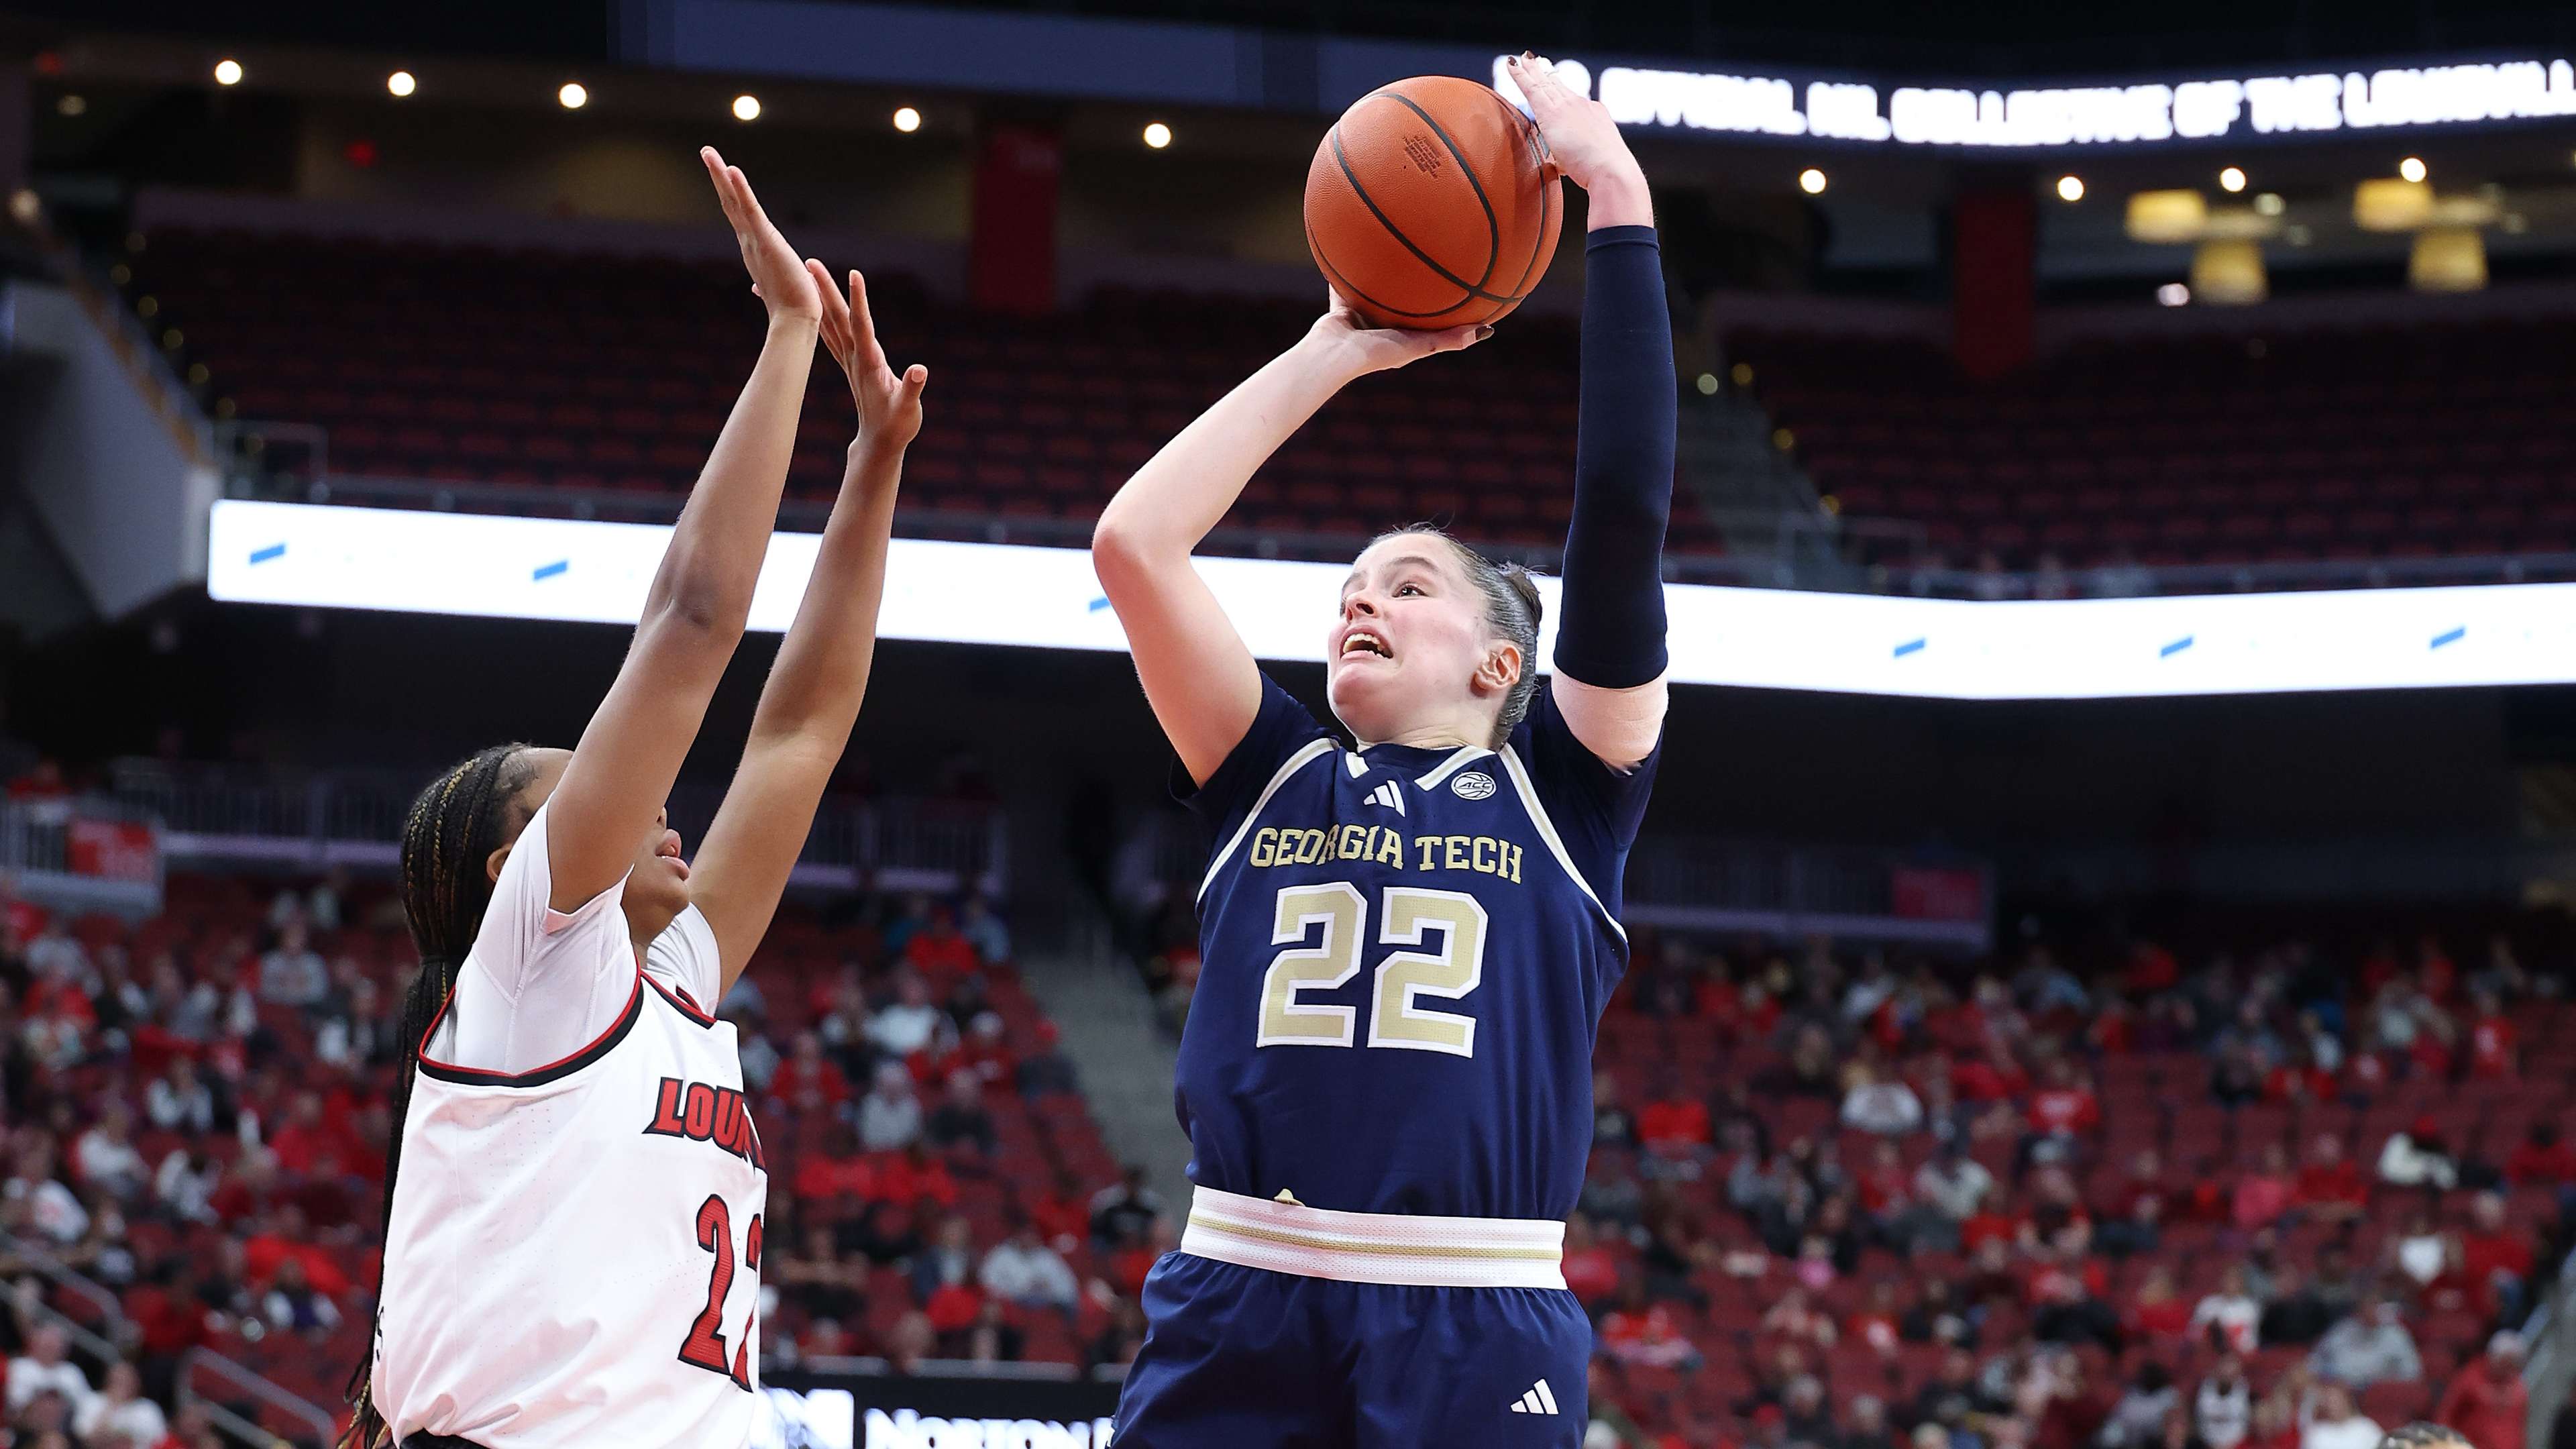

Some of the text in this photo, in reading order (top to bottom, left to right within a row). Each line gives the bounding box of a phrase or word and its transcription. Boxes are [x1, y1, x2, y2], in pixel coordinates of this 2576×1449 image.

[2173, 80, 2243, 138] OF
[2243, 73, 2343, 134] THE
[1250, 824, 1523, 884] GEORGIA TECH
[1256, 881, 1489, 1059] 22
